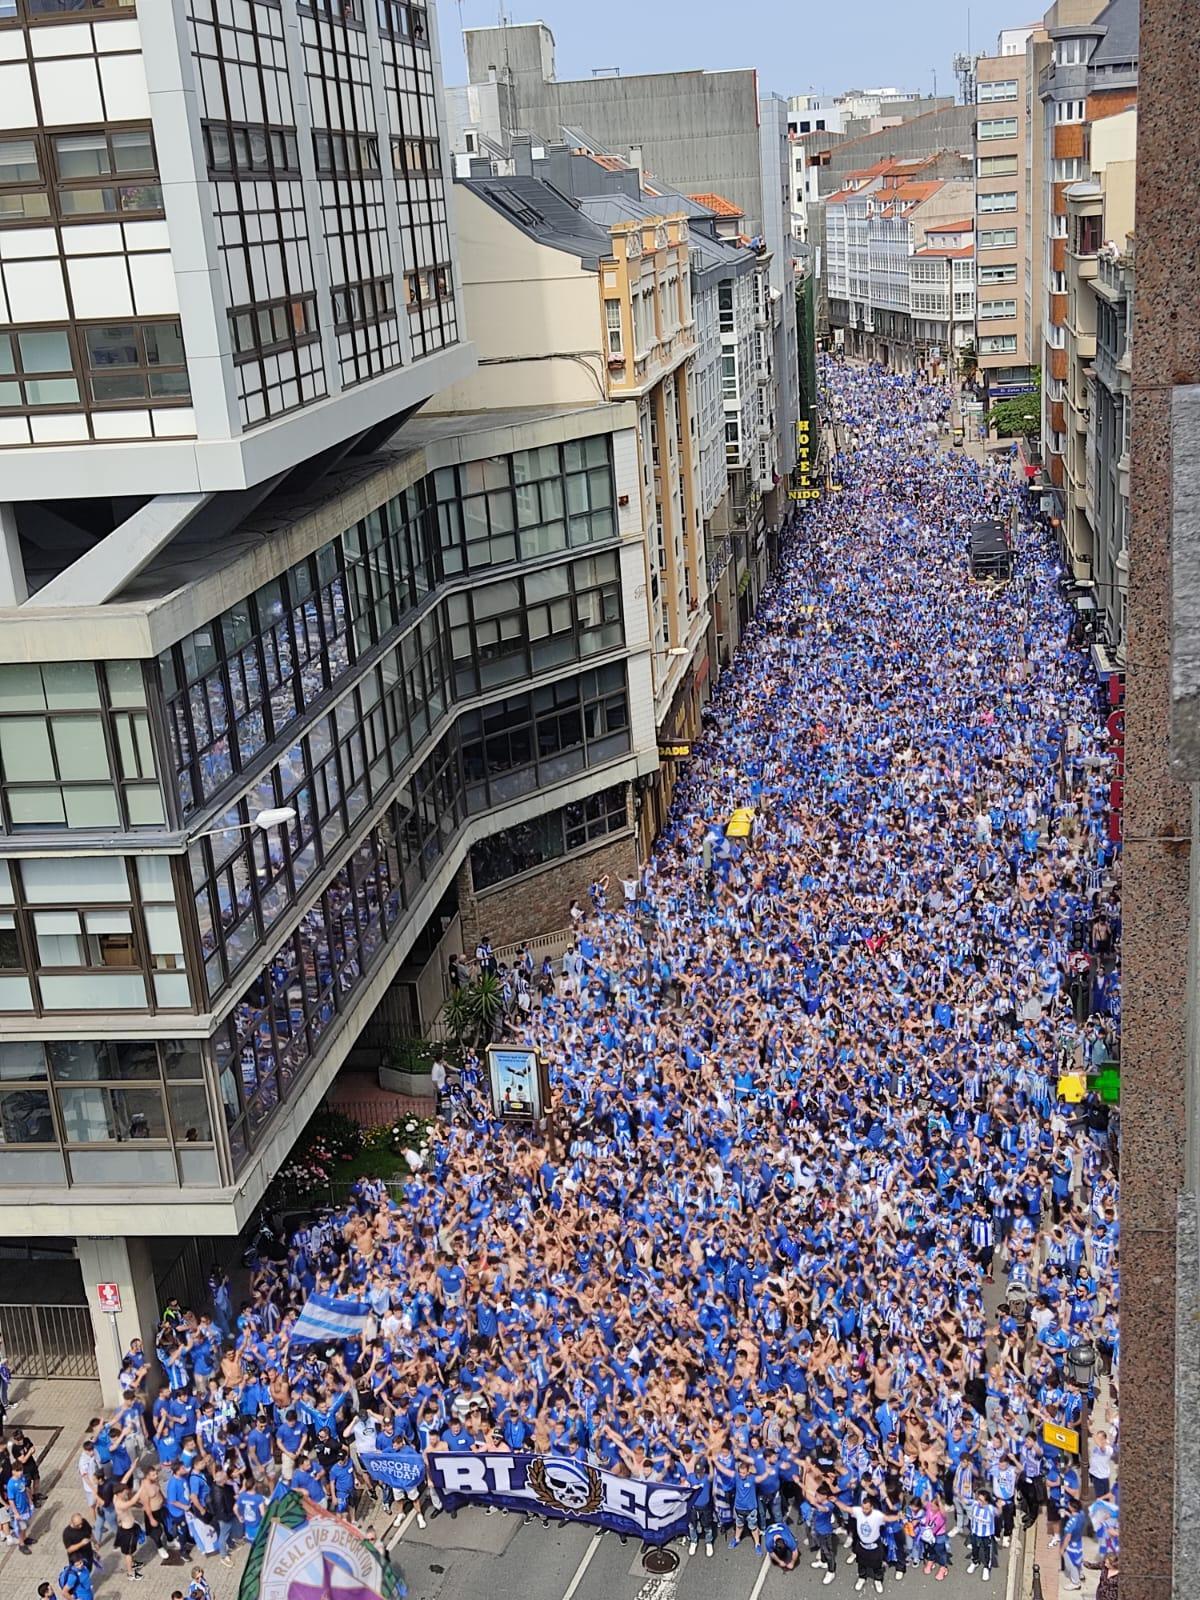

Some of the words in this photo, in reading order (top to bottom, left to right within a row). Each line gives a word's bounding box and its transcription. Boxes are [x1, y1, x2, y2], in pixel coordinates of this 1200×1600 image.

[799, 421, 811, 486] HOTEL
[788, 490, 820, 499] NIDO
[273, 1545, 305, 1577] REAL
